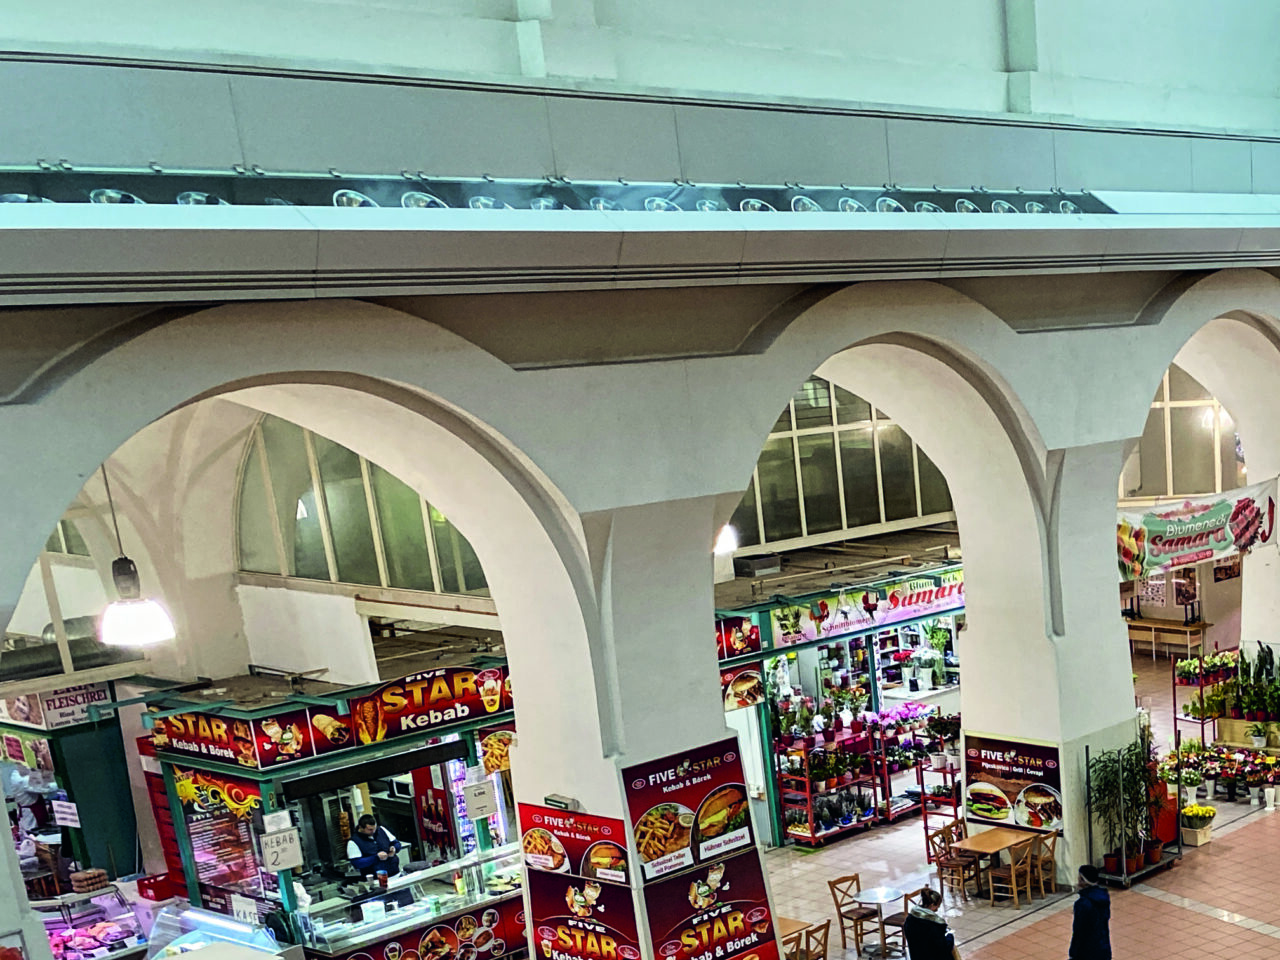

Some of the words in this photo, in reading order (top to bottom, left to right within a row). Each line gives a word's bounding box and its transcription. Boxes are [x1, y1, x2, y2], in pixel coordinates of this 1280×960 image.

[1166, 514, 1228, 536] Blumeneck
[1150, 527, 1228, 557] Samara
[405, 669, 446, 683] FIVE
[45, 689, 108, 711] FLEISCHREI
[382, 671, 479, 713] STAR
[400, 702, 470, 731] Kebab
[168, 713, 229, 744] STAR
[172, 738, 200, 752] Kebab
[200, 743, 209, 754] &
[209, 745, 235, 759] Börek
[981, 749, 1003, 762] FIVE
[1017, 755, 1043, 768] STAR
[648, 768, 676, 786] FIVE
[692, 756, 721, 774] STAR
[662, 782, 685, 794] Kebab
[685, 779, 691, 787] &
[692, 773, 712, 785] Börek
[544, 815, 564, 828] FIVE
[576, 822, 600, 835] STAR
[264, 833, 295, 850] KEBAB
[270, 850, 281, 867] 2
[692, 904, 733, 925] FIVE
[568, 919, 606, 934] FIVE
[681, 910, 745, 954] STAR
[557, 925, 617, 960] STAR
[715, 945, 725, 958] &
[726, 932, 759, 954] Börek
